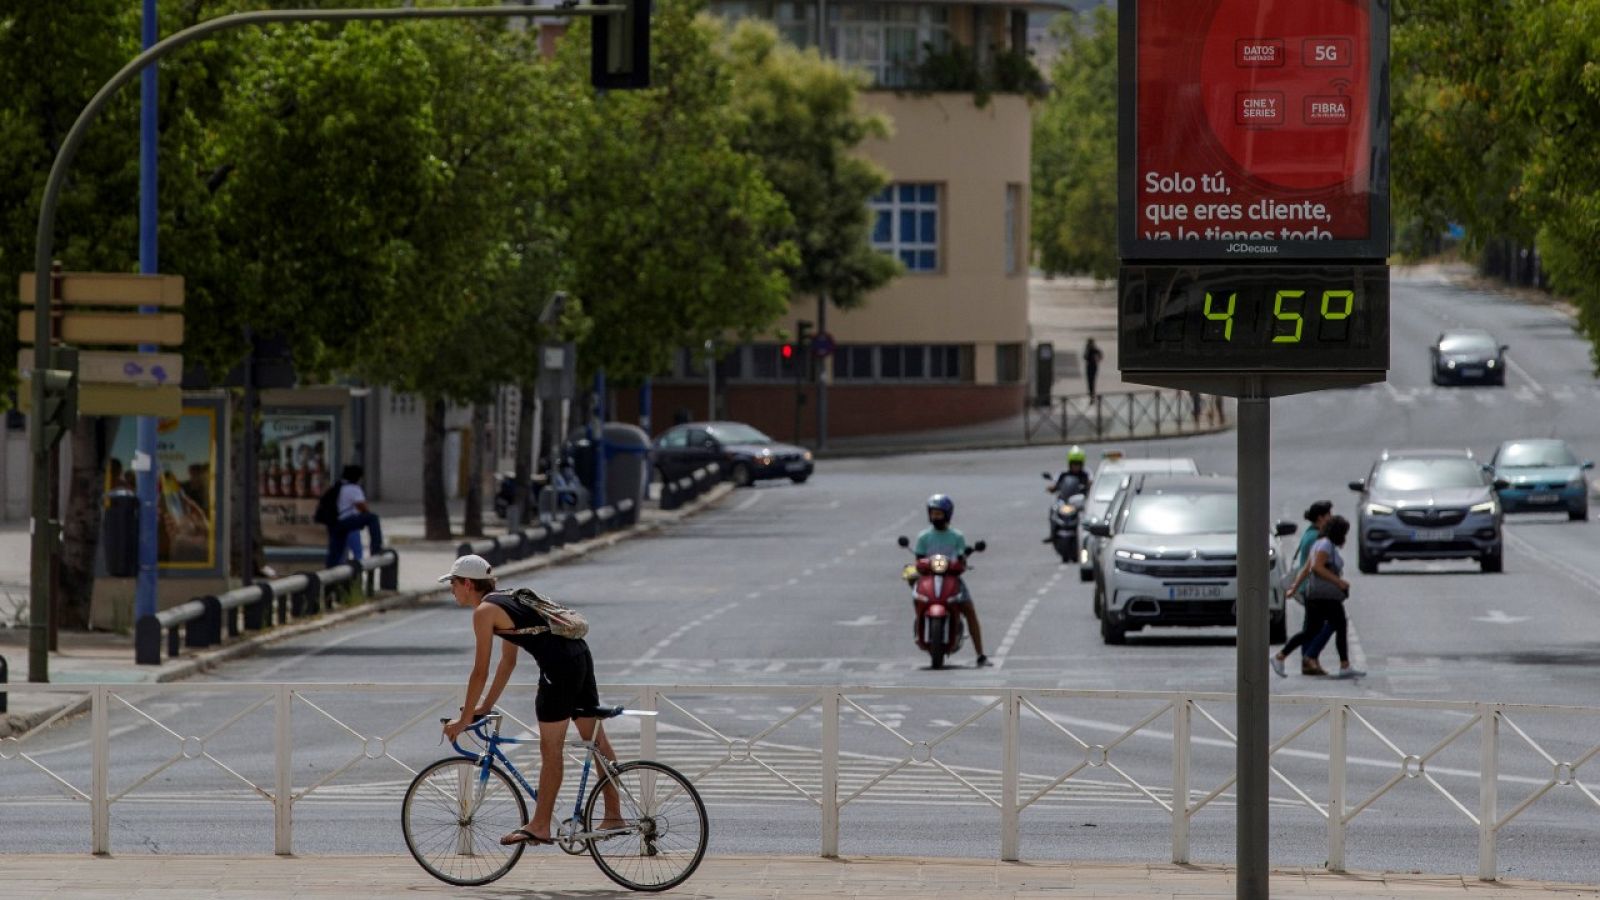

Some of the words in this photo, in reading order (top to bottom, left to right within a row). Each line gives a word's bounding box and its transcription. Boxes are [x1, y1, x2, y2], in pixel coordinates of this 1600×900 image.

[1243, 46, 1275, 55] DATOS
[1315, 46, 1337, 61] 5G
[1243, 99, 1267, 108] CINE
[1269, 98, 1276, 108] Y
[1311, 103, 1345, 113] FIBRA
[1243, 109, 1276, 118] SERIES
[1145, 172, 1196, 194] Solo
[1201, 171, 1231, 195] tú,
[1145, 204, 1188, 225] que
[1194, 204, 1243, 220] eres
[1248, 200, 1332, 222] cliente,
[1226, 243, 1278, 253] JCDecaux
